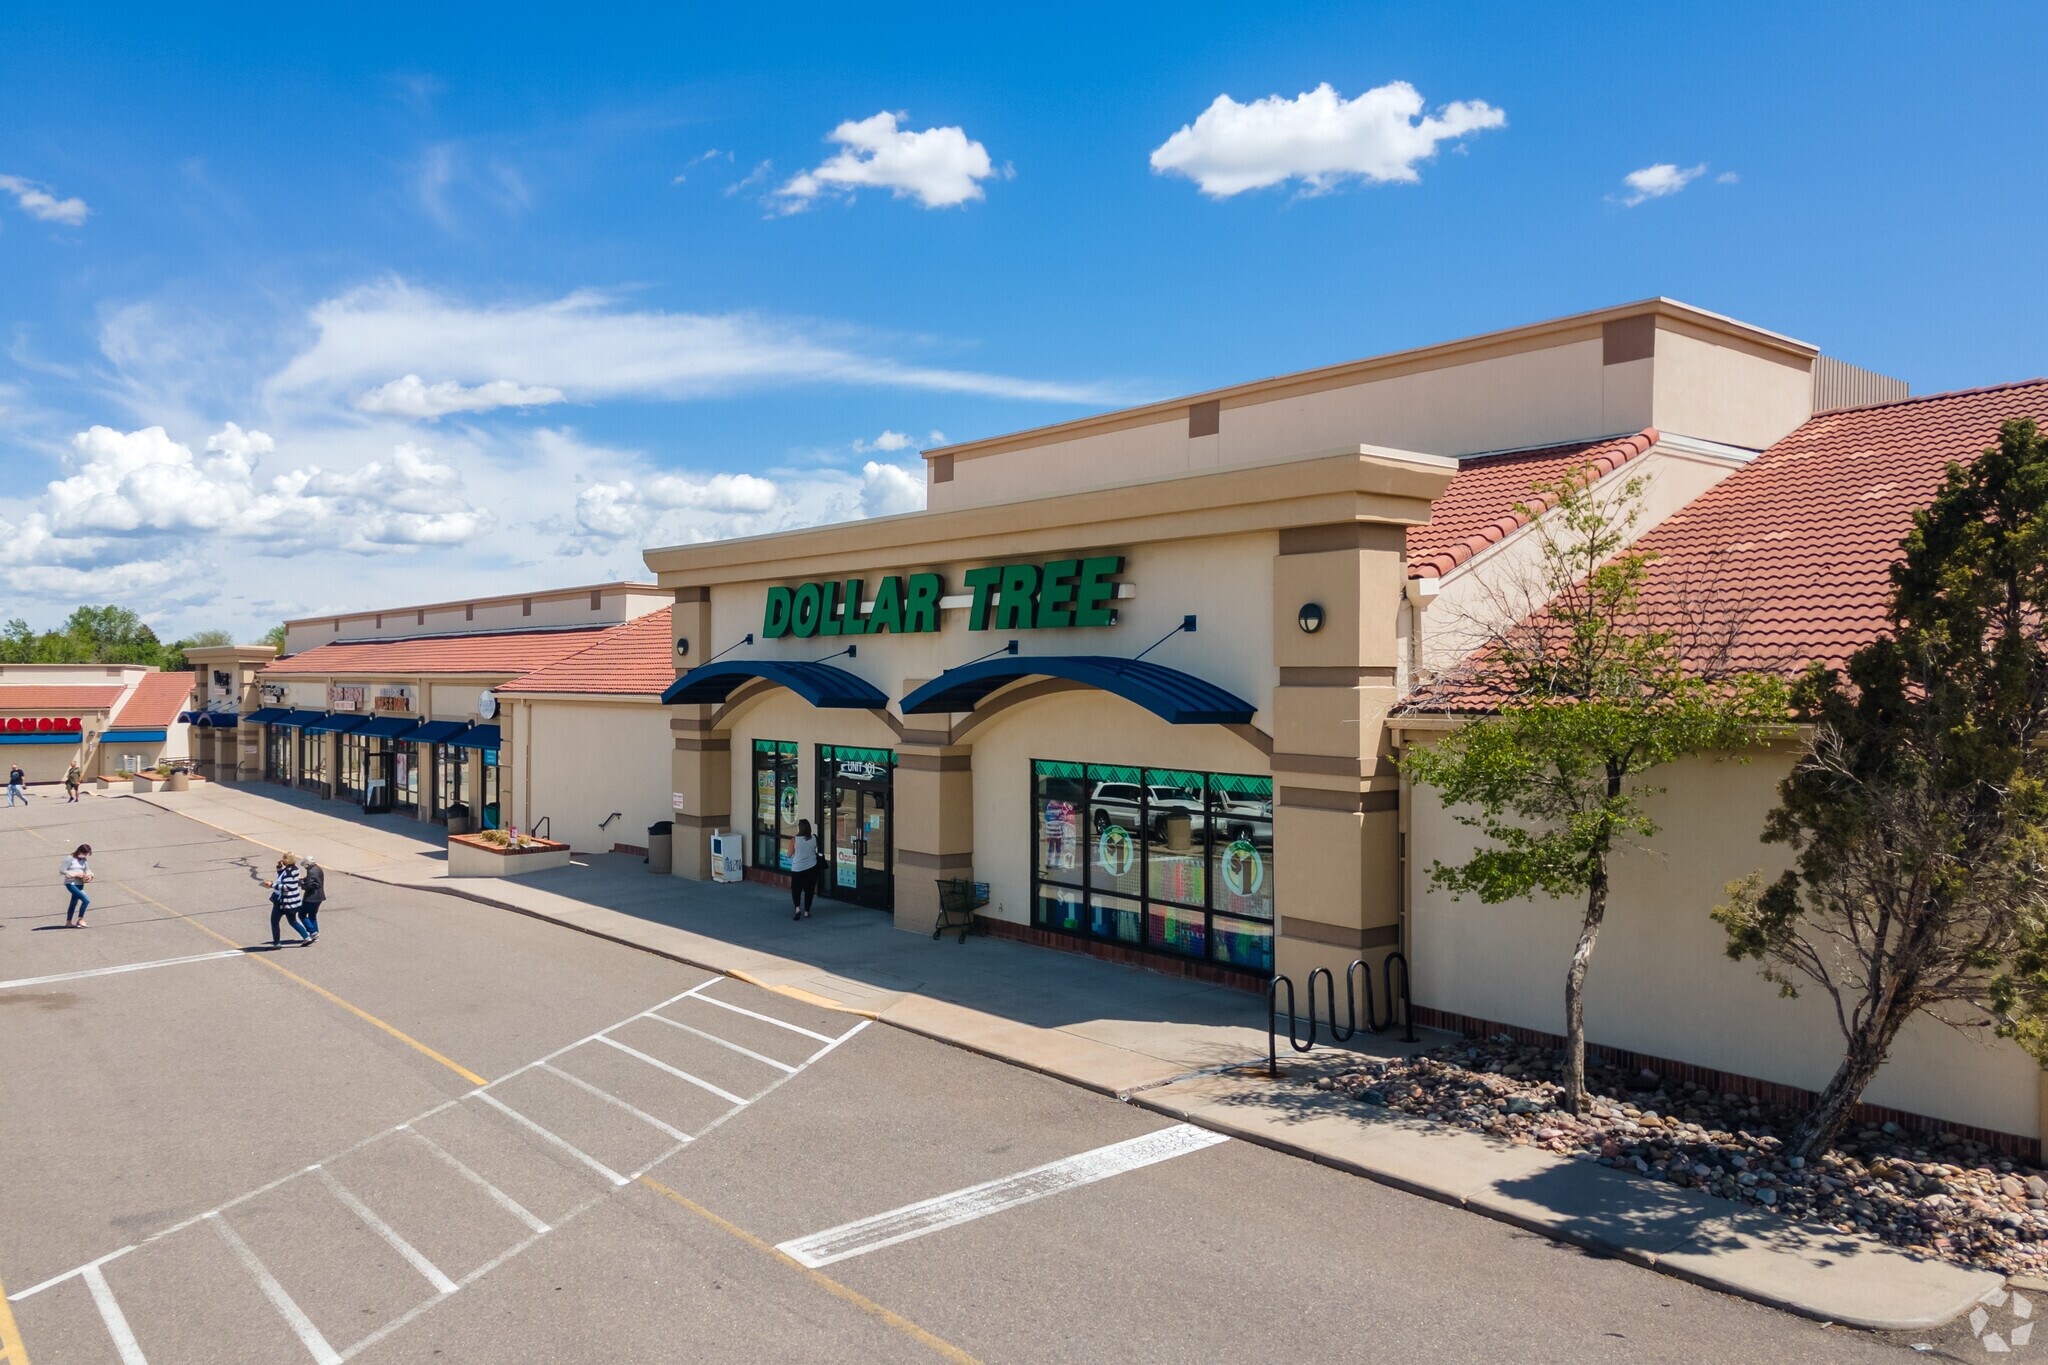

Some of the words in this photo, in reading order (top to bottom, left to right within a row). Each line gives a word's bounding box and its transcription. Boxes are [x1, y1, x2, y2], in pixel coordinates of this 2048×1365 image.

[763, 572, 945, 639] DOLLAR
[964, 556, 1125, 631] TREE
[847, 761, 863, 772] UNIT
[865, 762, 875, 774] 101
[839, 851, 855, 864] Open
